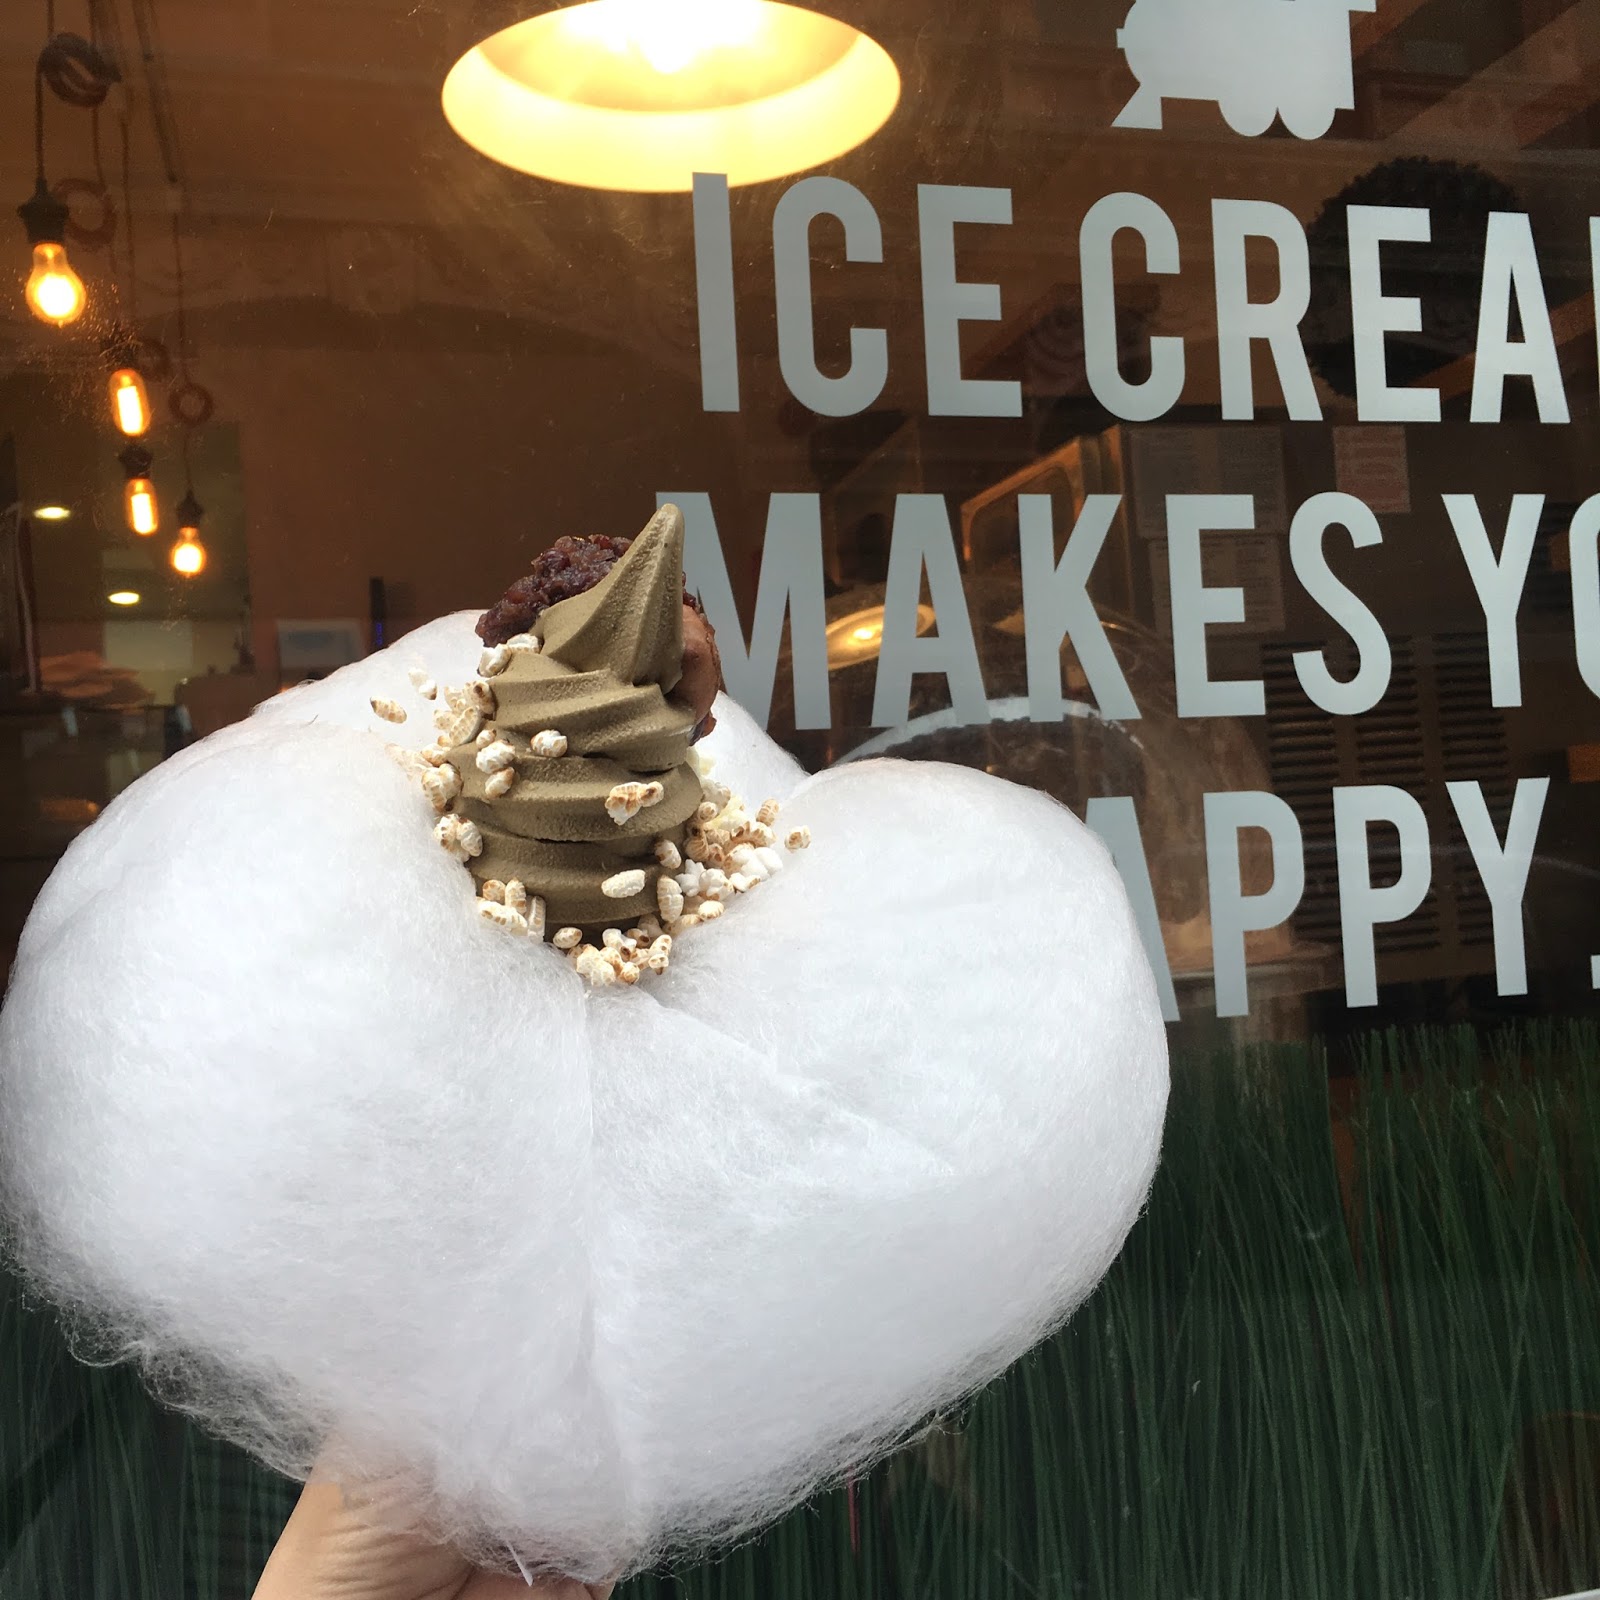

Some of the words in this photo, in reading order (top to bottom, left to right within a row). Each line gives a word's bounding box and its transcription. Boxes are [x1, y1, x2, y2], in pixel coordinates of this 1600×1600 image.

[692, 173, 1023, 418] ICE
[1079, 192, 1600, 423] CREA
[655, 491, 1392, 731] MAKES
